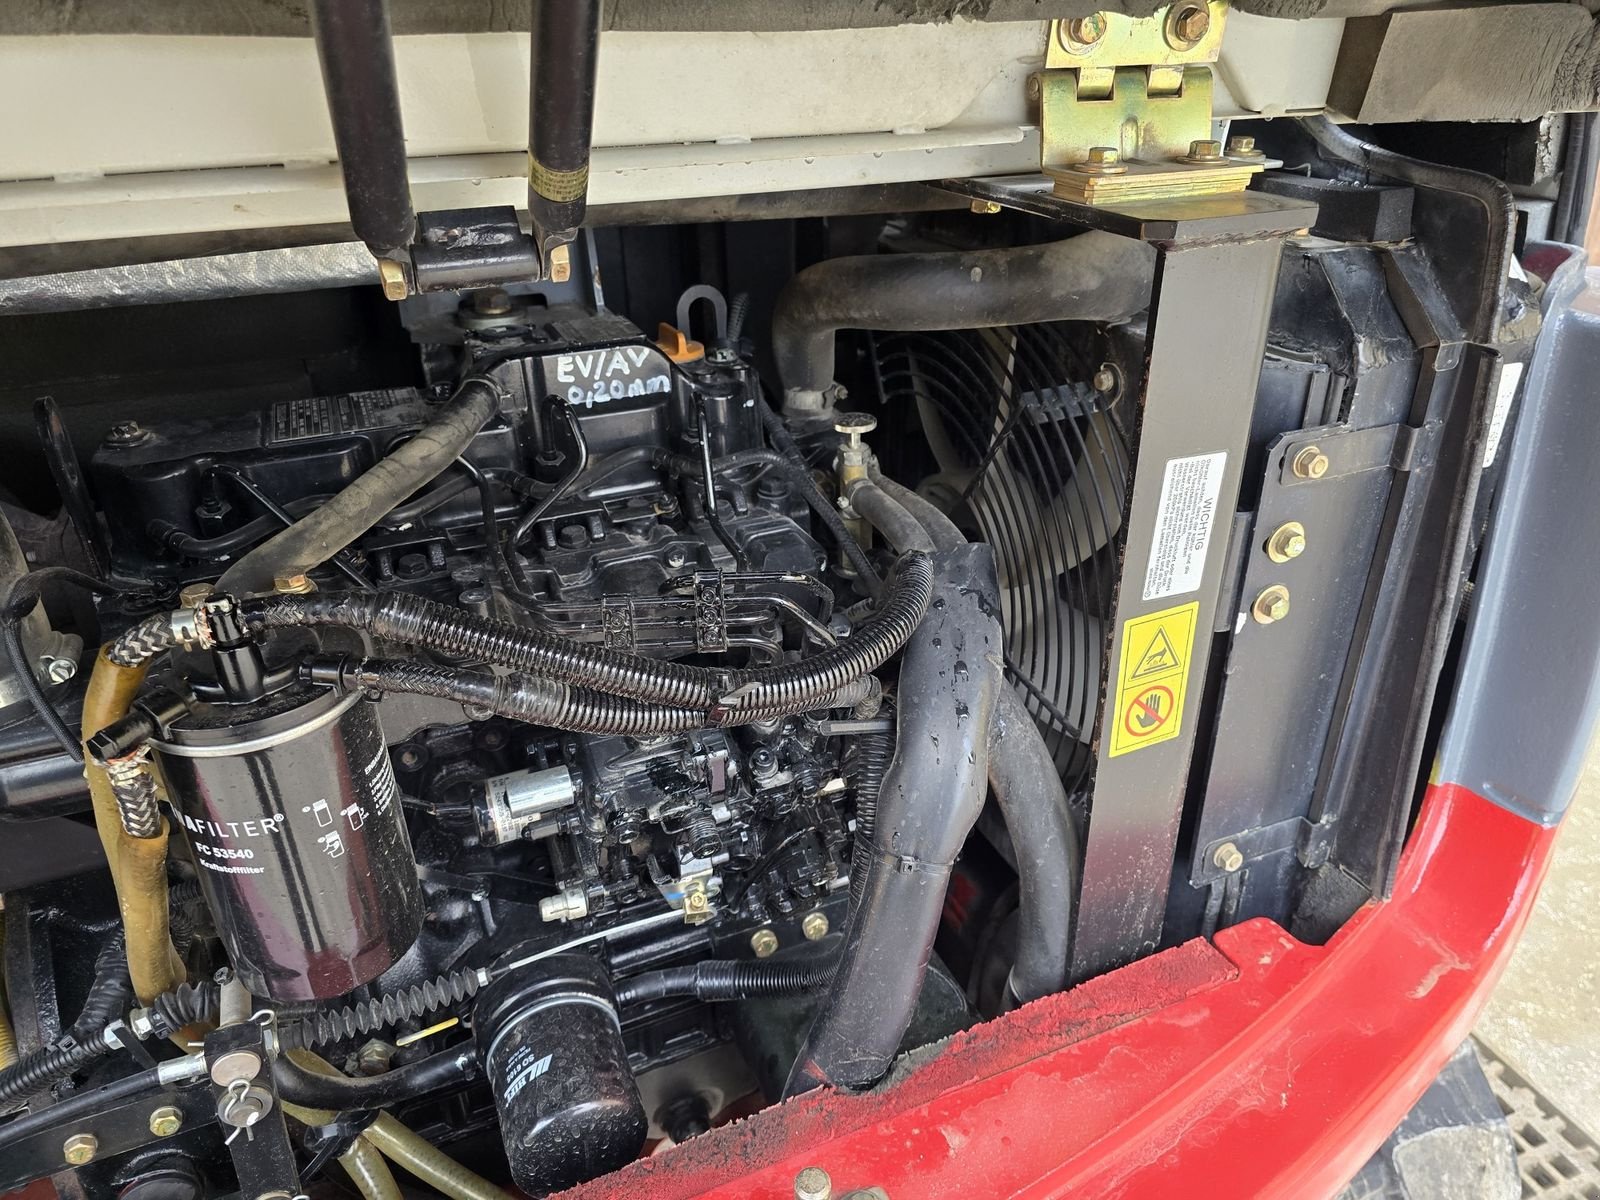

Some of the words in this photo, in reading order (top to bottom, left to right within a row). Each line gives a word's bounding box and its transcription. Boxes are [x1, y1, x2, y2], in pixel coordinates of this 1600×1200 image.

[557, 347, 650, 382] EV/AV
[1194, 497, 1213, 550] WICHTIG
[195, 841, 212, 856] FC
[212, 846, 254, 859] 53540
